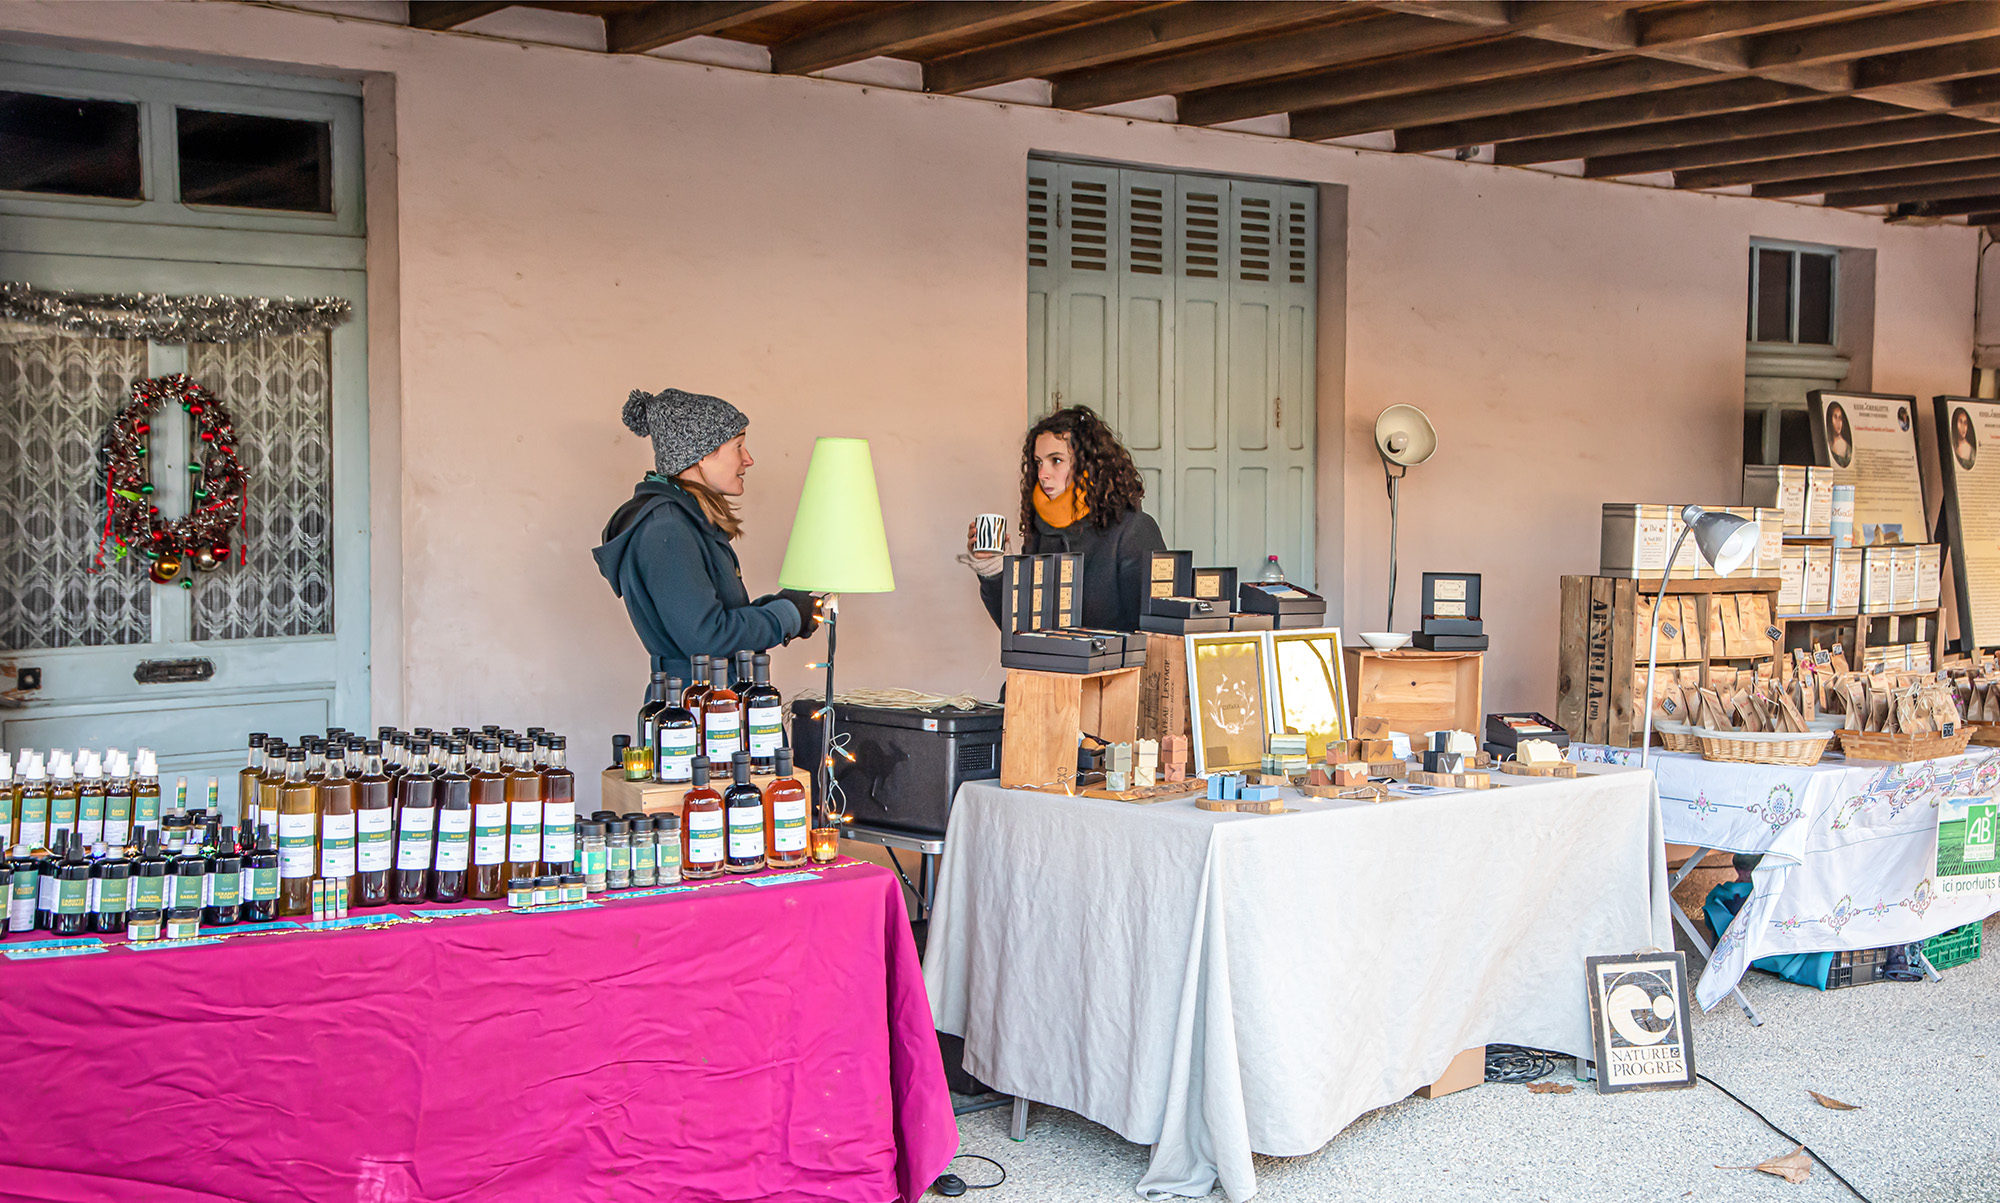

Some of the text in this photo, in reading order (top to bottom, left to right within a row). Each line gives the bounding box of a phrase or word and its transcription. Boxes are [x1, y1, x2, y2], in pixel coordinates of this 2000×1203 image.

[1161, 659, 1170, 699] LESTAGE
[1968, 817, 1991, 844] AB
[1942, 879, 1953, 892] ici
[1956, 876, 1995, 894] produits
[1612, 1048, 1669, 1062] NATURE
[1613, 1060, 1683, 1077] PROGRES
